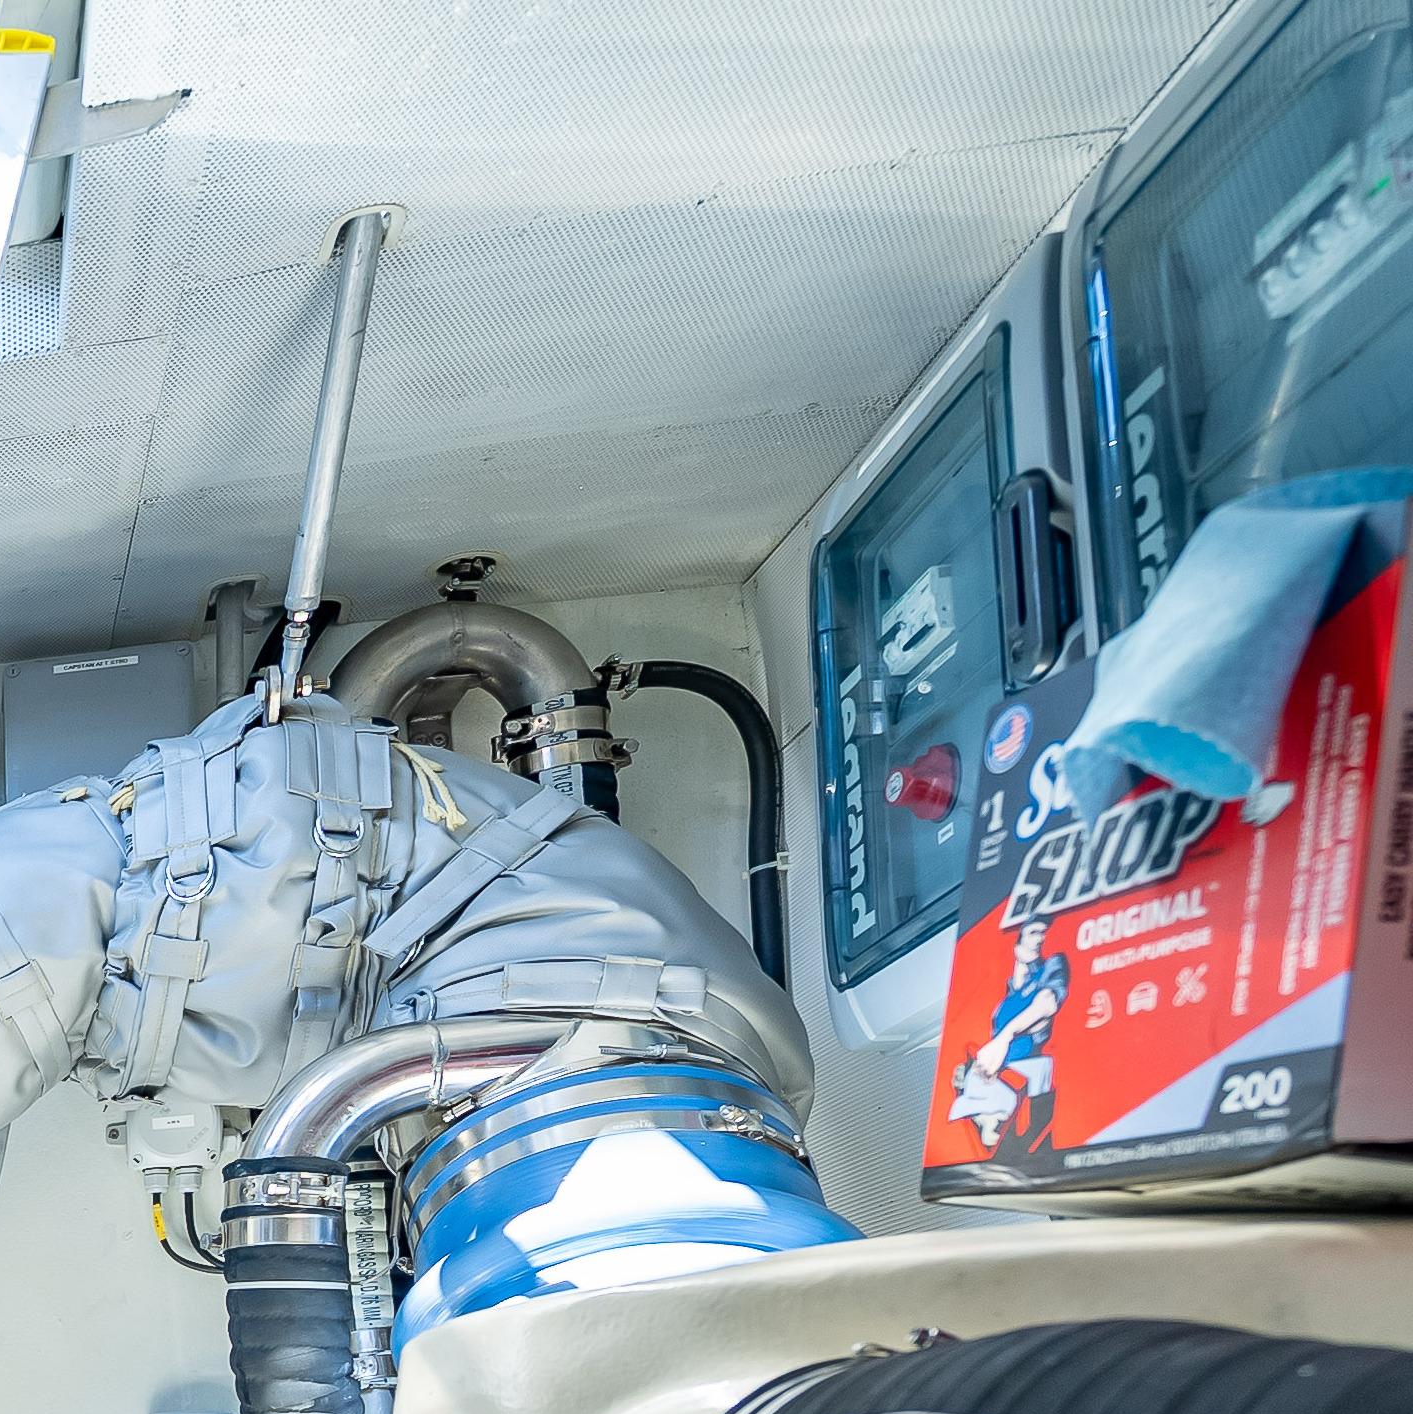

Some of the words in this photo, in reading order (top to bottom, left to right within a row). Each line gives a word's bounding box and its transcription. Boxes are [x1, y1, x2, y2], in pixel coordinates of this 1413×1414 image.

[840, 664, 876, 939] legrand
[1000, 788, 1223, 929] SHOP
[1076, 887, 1209, 951] ORIGINAL
[1220, 1066, 1292, 1114] 200
